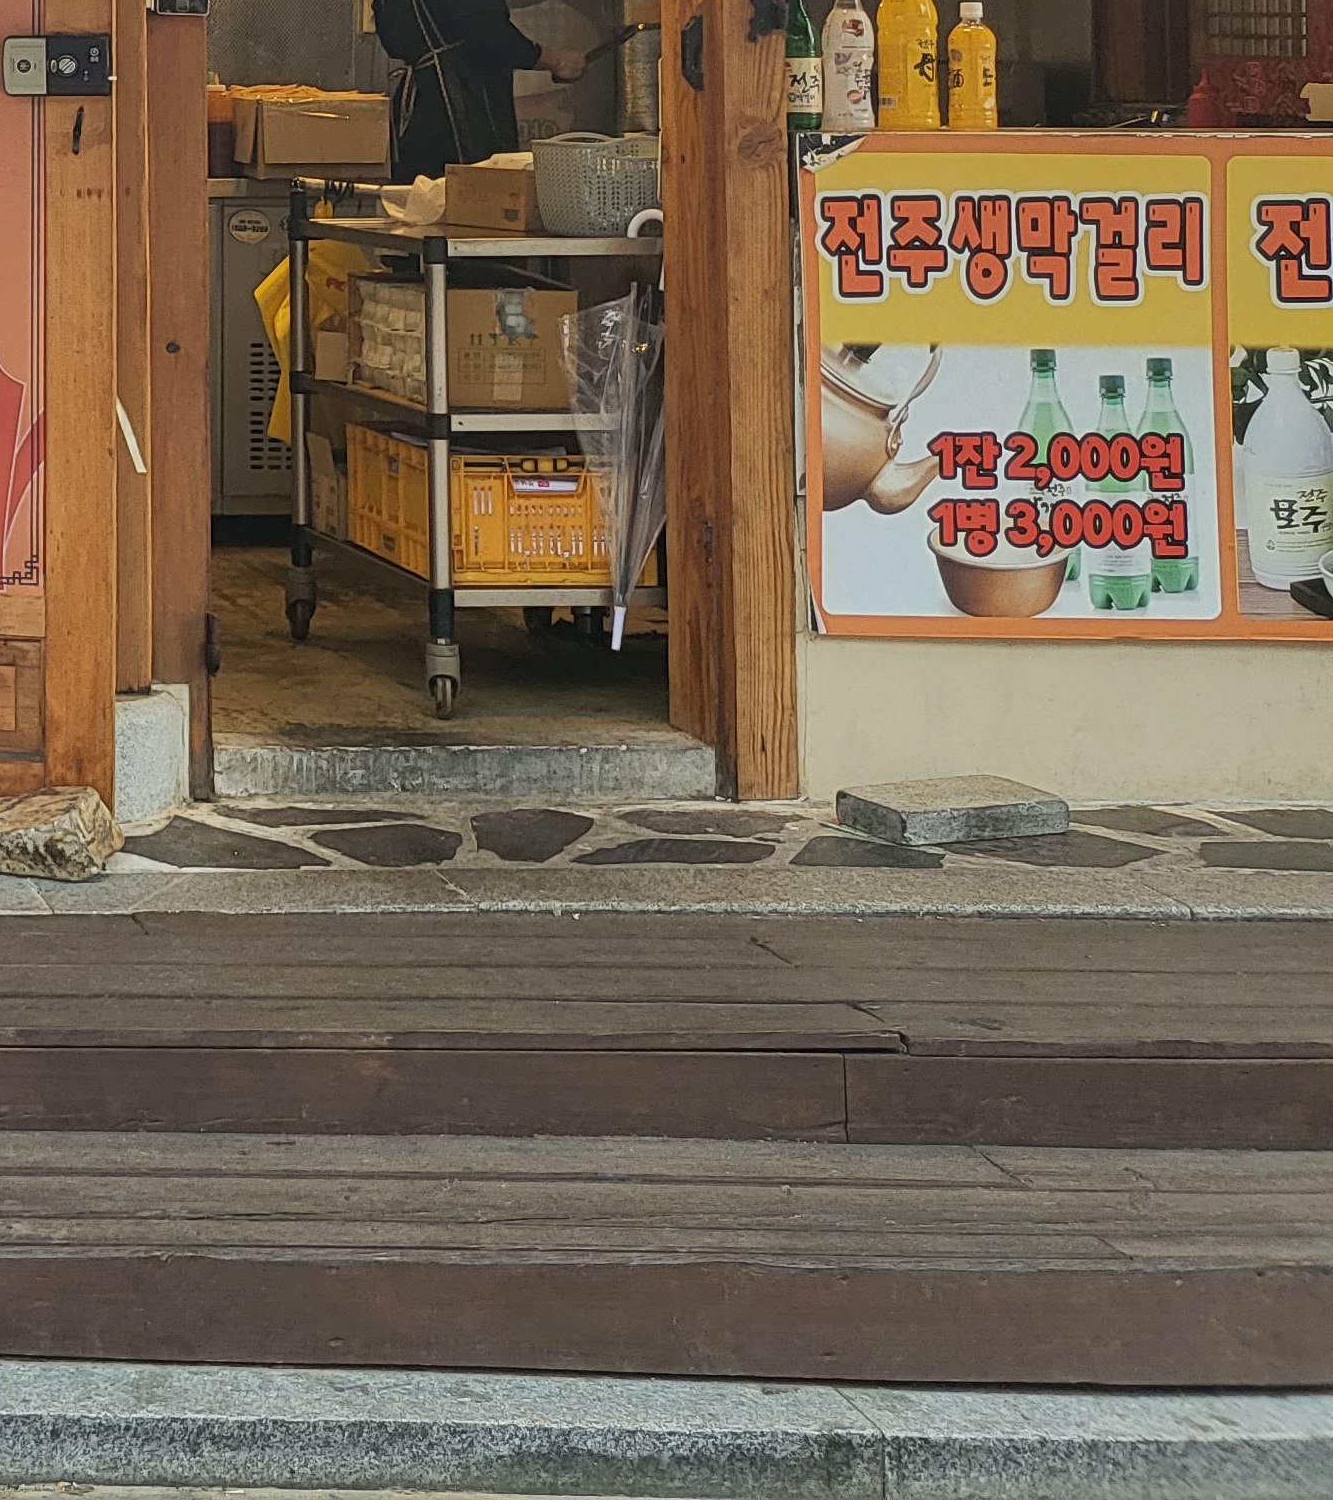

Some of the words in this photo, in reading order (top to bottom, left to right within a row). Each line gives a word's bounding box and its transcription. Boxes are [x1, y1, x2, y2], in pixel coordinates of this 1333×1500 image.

[817, 191, 1209, 304] 전주생막걸리
[927, 431, 1002, 491] 1잔
[1004, 432, 1186, 490] 2,000원
[927, 498, 1001, 559] 1병
[1005, 498, 1189, 559] 3,000원
